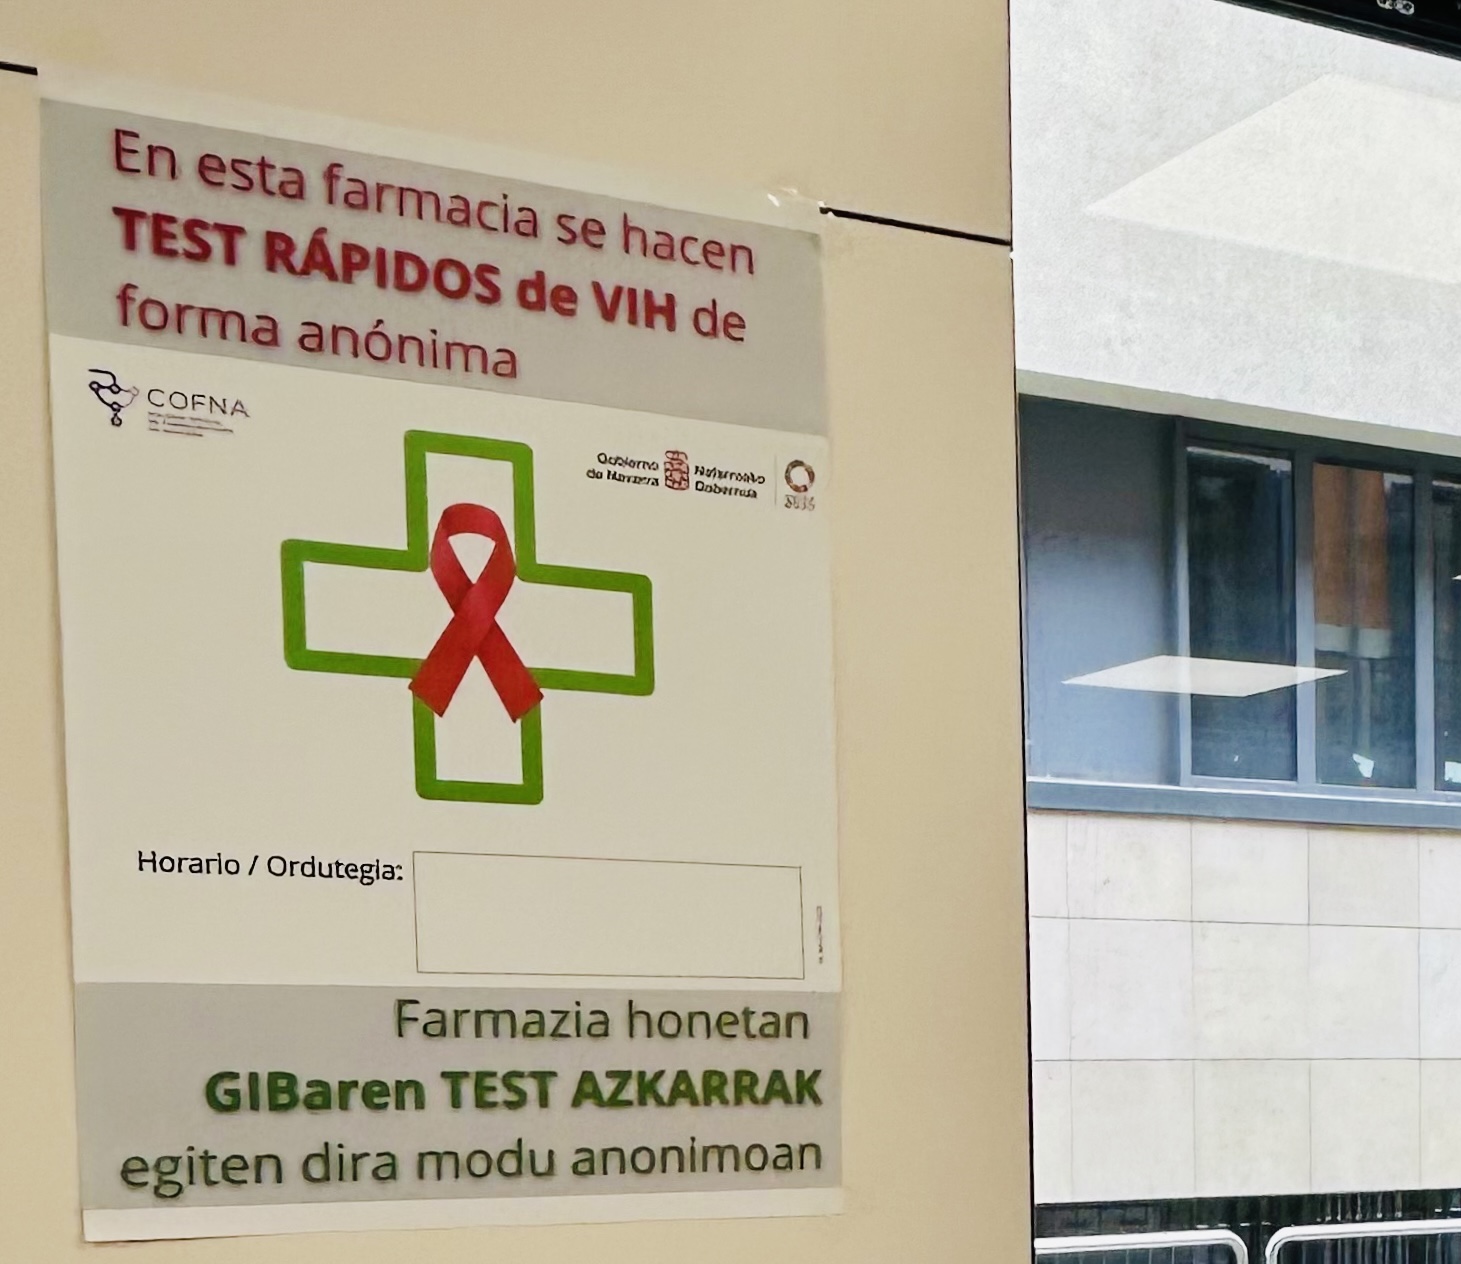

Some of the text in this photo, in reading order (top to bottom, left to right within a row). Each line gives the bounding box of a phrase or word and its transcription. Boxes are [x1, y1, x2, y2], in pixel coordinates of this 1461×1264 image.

[110, 128, 755, 276] En esta farmacia se hacen
[112, 206, 747, 344] TEST RÁPIDOS de VIH de
[115, 283, 519, 382] forma anónima
[147, 388, 250, 418] COFNA
[138, 850, 241, 876] Horario
[266, 855, 404, 886] Ordutegia:
[394, 999, 811, 1041] Farmazia honetan
[203, 1069, 823, 1116] GIBaren TEST AZKARRAK
[120, 1135, 823, 1202] egiten dira modu anonimoan
